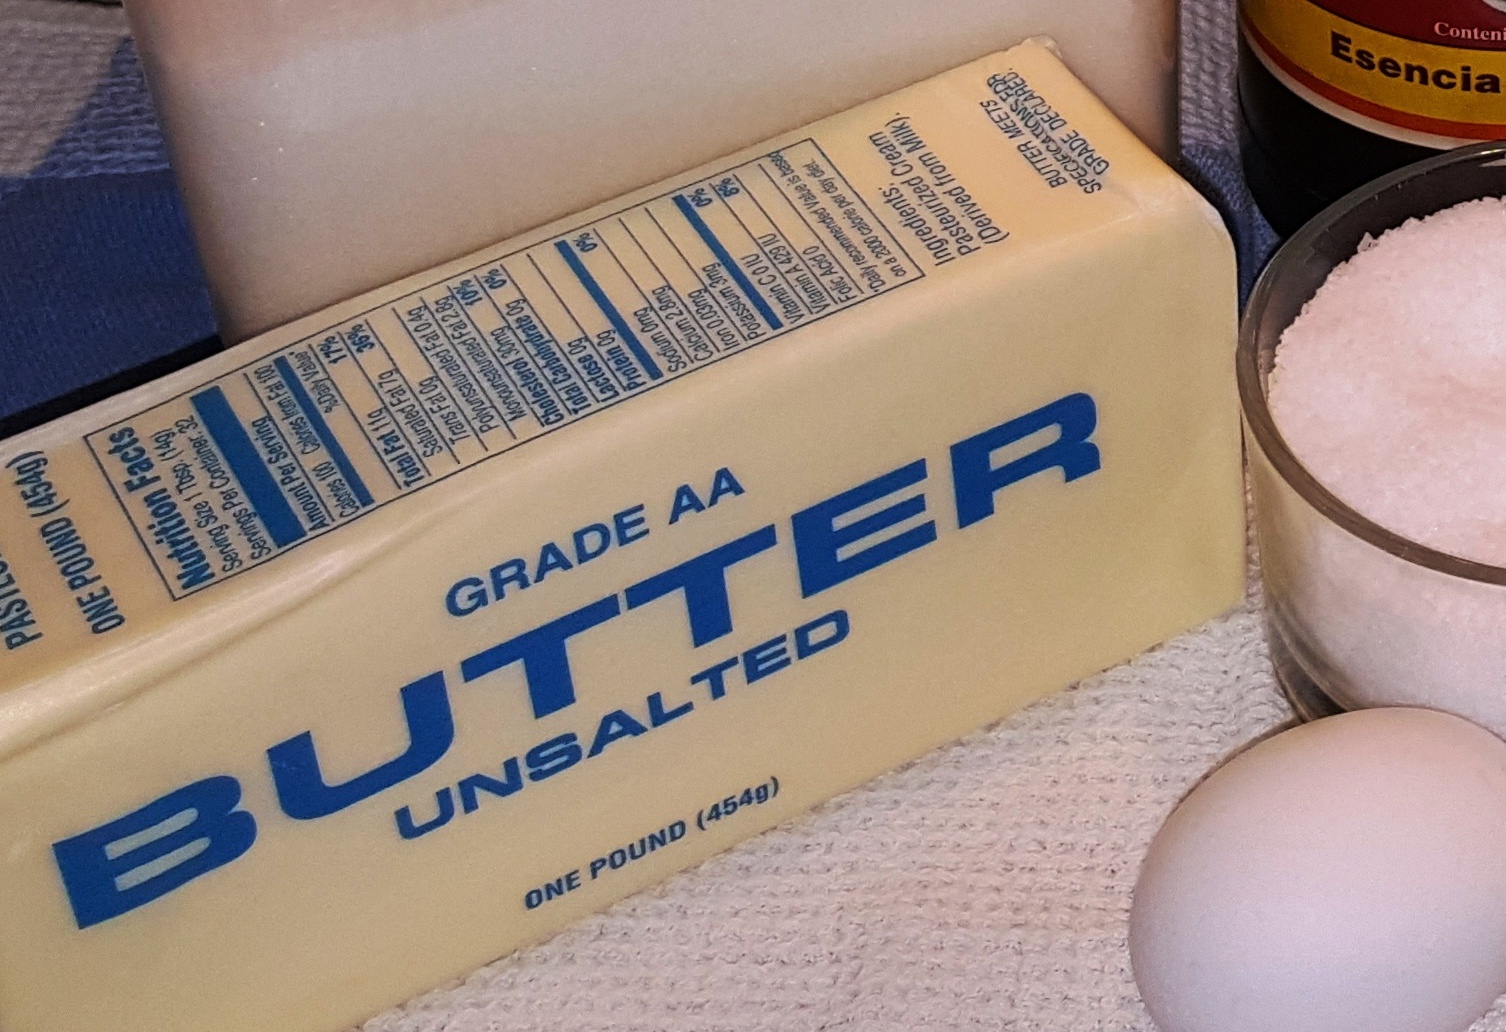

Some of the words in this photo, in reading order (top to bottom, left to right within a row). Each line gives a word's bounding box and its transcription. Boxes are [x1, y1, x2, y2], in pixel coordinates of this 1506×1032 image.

[1331, 30, 1501, 94] Esencia
[986, 73, 1021, 103] FOR
[884, 112, 927, 154] Milk).
[979, 99, 1026, 140] MEETS
[868, 131, 914, 177] Cream
[1016, 140, 1069, 189] BUTTER
[1059, 129, 1110, 176] GRADE
[686, 187, 714, 208] 0%
[794, 183, 821, 211] Value
[830, 193, 854, 209] per
[941, 185, 1011, 245] (Derived
[877, 182, 957, 267] Ingredients:
[899, 175, 982, 257] Pasteurized
[572, 232, 599, 253] 0%
[757, 232, 781, 248] IU
[809, 207, 868, 266] recommended
[862, 235, 892, 260] 2000
[739, 253, 764, 269] IU
[768, 245, 794, 265] 429
[807, 253, 839, 277] Acid
[452, 278, 484, 307] 10%
[480, 268, 508, 290] 0%
[700, 261, 729, 289] 3mg
[829, 275, 858, 304] Folic
[433, 293, 466, 323] 2.8g
[504, 298, 529, 317] 0g
[651, 283, 690, 321] 2.8mg
[686, 285, 732, 330] 0.03mg
[768, 283, 806, 325] Vitamin
[793, 273, 832, 315] Vitamin
[406, 304, 435, 333] 0.4g
[444, 318, 472, 341] Fat
[632, 306, 660, 334] 0mg
[718, 285, 767, 341] Potassium
[316, 335, 348, 365] 17%
[344, 323, 376, 354] 36%
[418, 329, 445, 352] Fat
[489, 324, 526, 360] 30mg
[514, 314, 573, 386] Carbohydrate
[566, 336, 589, 356] 0g
[595, 328, 617, 348] 0g
[650, 330, 688, 374] Sodium
[674, 316, 715, 362] Calcium
[716, 326, 741, 352] Iron
[253, 364, 279, 385] 100
[376, 367, 401, 389] 7g
[418, 374, 444, 395] 0g
[456, 336, 528, 423] Monounsaturated
[576, 353, 621, 403] Lactose
[604, 344, 648, 392] Protein
[263, 379, 289, 402] Fat
[383, 383, 411, 408] Fat
[423, 391, 451, 415] Fat
[429, 347, 501, 435] Polyunsaturated
[503, 356, 565, 426] Cholesterol
[557, 381, 593, 416] Total
[173, 414, 199, 435] 32
[288, 416, 322, 456] Calories
[366, 406, 393, 433] 11g
[394, 403, 444, 459] Saturated
[438, 410, 472, 446] Trans
[147, 427, 185, 463] (14g)
[250, 415, 289, 465] Serving
[375, 428, 406, 456] Fat
[106, 426, 162, 494] Facts
[276, 461, 302, 487] Per
[310, 460, 338, 482] 100
[388, 451, 426, 488] Total
[4, 450, 71, 519] (454g)
[218, 487, 245, 513] Per
[325, 477, 362, 519] Calories
[192, 500, 219, 529] Size
[286, 480, 331, 533] Amount
[142, 487, 217, 591] Nutrition
[205, 523, 244, 574] Serving
[231, 507, 273, 561] Servings
[443, 502, 649, 620] GRADE
[667, 466, 746, 526] AA
[38, 516, 103, 592] POUND
[75, 585, 126, 635] ONE
[51, 391, 1102, 931] BUTTER
[394, 609, 851, 841] UNSALTED
[524, 869, 582, 910] ONE
[589, 819, 687, 880] POUND
[696, 776, 780, 831] (454g)
